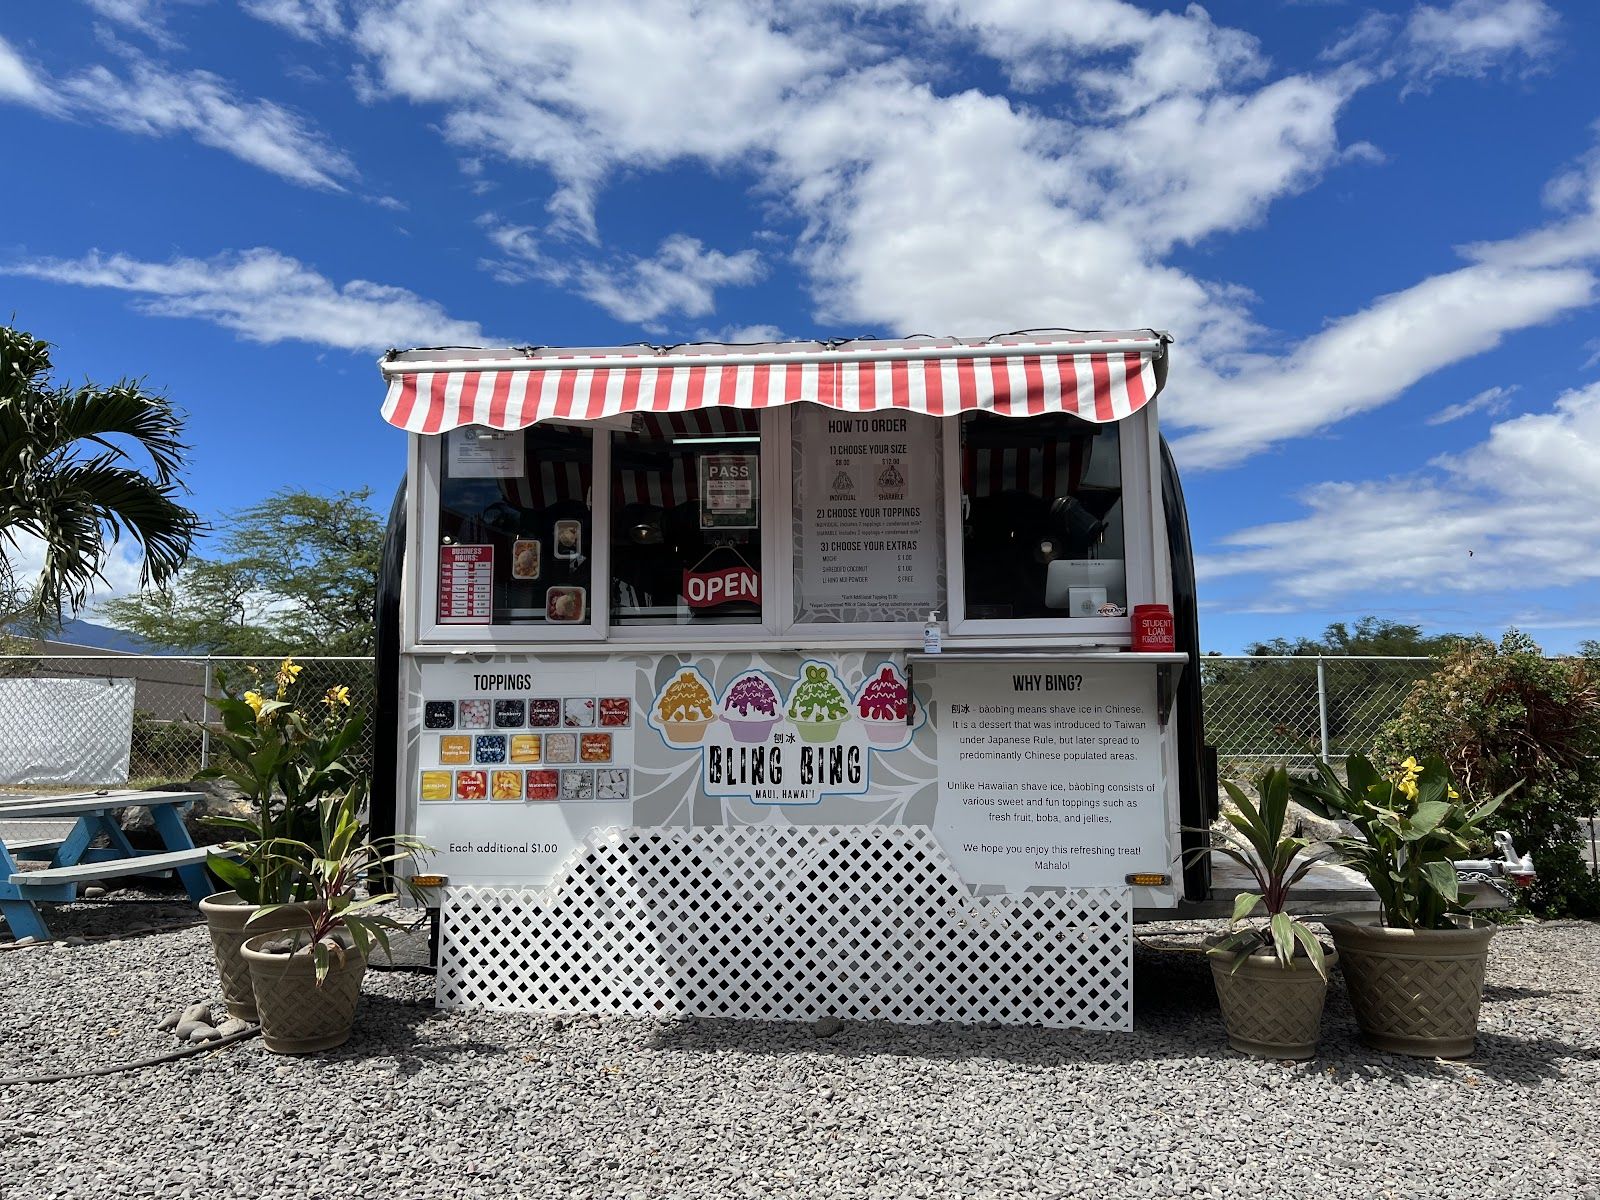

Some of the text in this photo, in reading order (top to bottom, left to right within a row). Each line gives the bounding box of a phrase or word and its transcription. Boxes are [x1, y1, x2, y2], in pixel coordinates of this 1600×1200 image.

[828, 418, 906, 433] HOW TO ORDER
[838, 444, 868, 455] CHOOSE
[869, 444, 889, 454] YOUR
[890, 444, 907, 454] SIZE
[709, 466, 749, 478] PASS
[827, 508, 858, 518] CHOOSE
[860, 508, 880, 518] YOUR
[882, 507, 920, 517] TOPPINGS
[831, 541, 861, 551] CHOOSE
[863, 541, 884, 551] YOUR
[886, 540, 917, 550] EXTRAS
[688, 572, 758, 601] OPEN
[1142, 619, 1171, 627] STUDENT
[473, 674, 531, 691] TOPPINGS
[1012, 674, 1082, 691] WHY BING?
[1050, 705, 1076, 714] shave
[1079, 705, 1092, 714] ice
[1094, 704, 1102, 713] in
[1105, 704, 1144, 714] Chinese.
[960, 720, 968, 729] is
[979, 720, 1012, 729] dessert
[1014, 720, 1031, 729] that
[1054, 720, 1100, 729] introduced
[1114, 720, 1146, 729] Taiwan
[960, 736, 985, 744] under
[988, 735, 1030, 746] Japanese
[1033, 736, 1056, 744] Rule,
[1059, 736, 1073, 744] but
[1076, 736, 1095, 744] later
[1098, 737, 1128, 746] spread
[960, 751, 1022, 762] predominantly
[1024, 751, 1061, 760] Chinese
[1064, 751, 1107, 762] populated
[710, 745, 860, 785] BLING BING
[947, 781, 974, 790] Unlike
[978, 782, 1018, 790] Hawaiian
[1107, 782, 1144, 792] consists
[1146, 783, 1155, 792] of
[755, 790, 778, 799] MAUI,
[962, 796, 995, 806] various
[1026, 798, 1043, 806] and
[1045, 797, 1060, 806] fun
[1062, 798, 1100, 809] toppings
[1102, 798, 1124, 807] such
[989, 812, 1010, 822] fresh
[1014, 813, 1034, 822] fruit,
[1064, 814, 1081, 823] and
[450, 842, 558, 853] Each additional $1.00
[963, 844, 1141, 857] We hope you enjoy this refreshing treat!
[1035, 860, 1070, 870] Mahalo!
